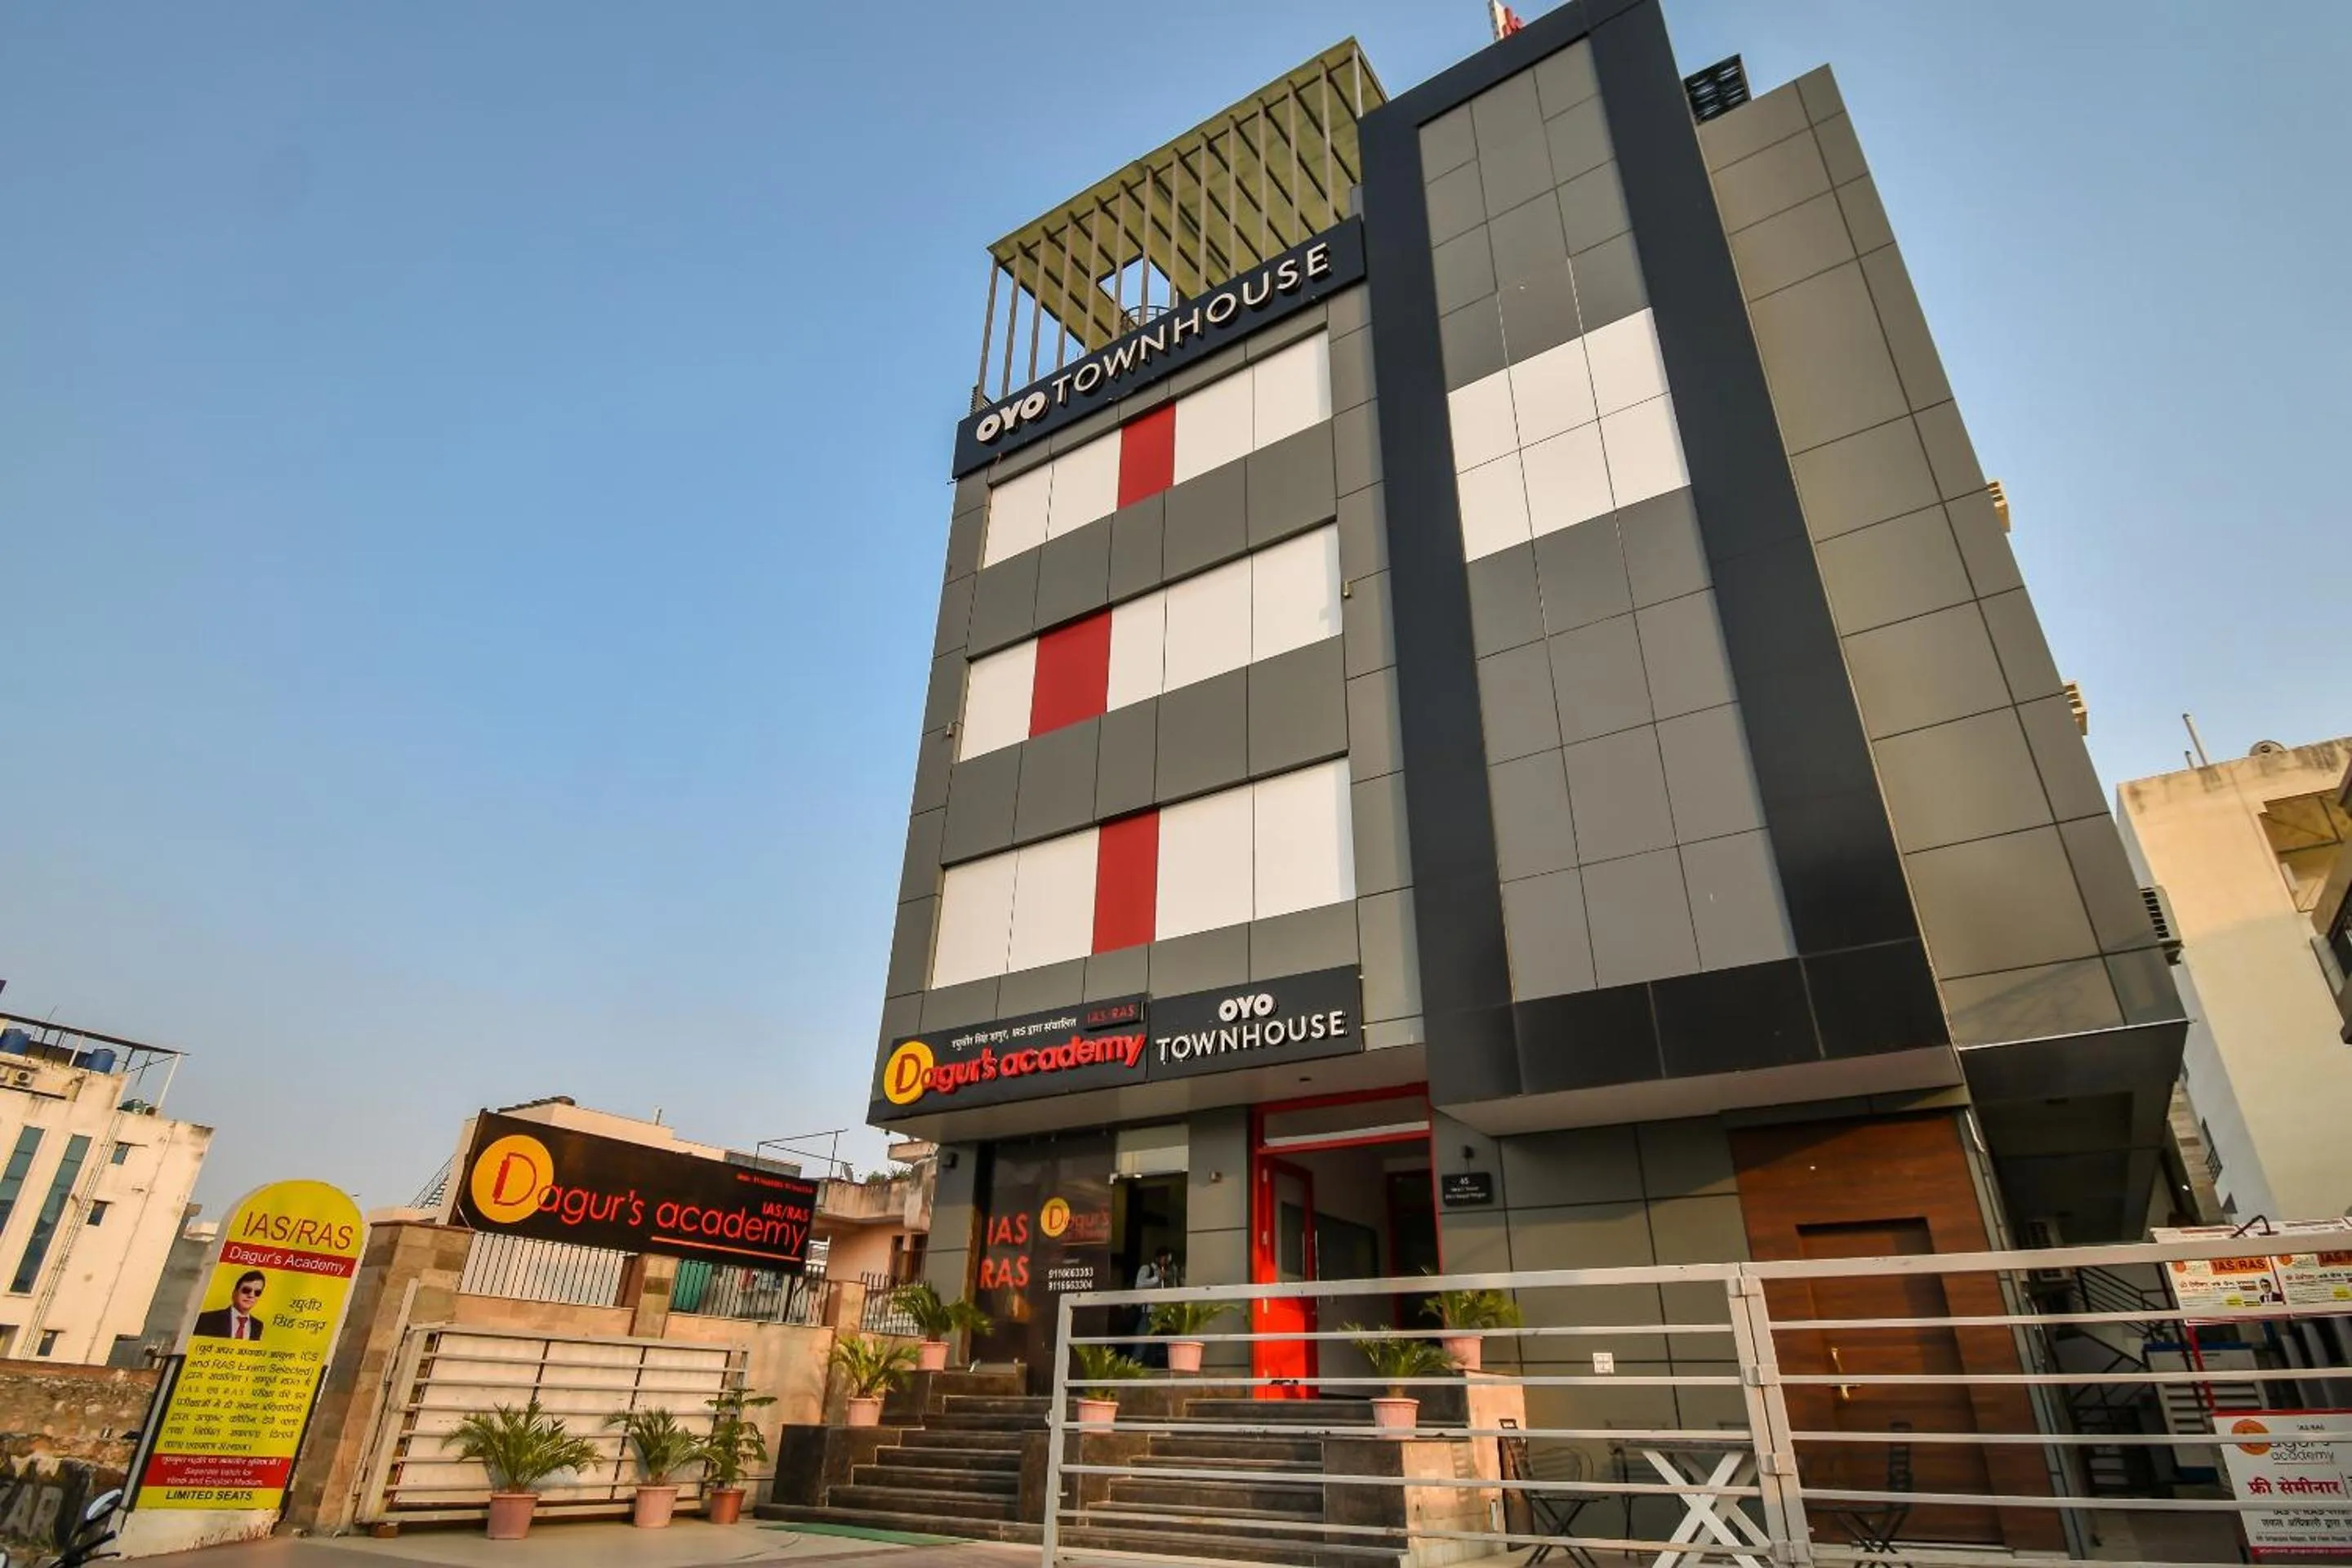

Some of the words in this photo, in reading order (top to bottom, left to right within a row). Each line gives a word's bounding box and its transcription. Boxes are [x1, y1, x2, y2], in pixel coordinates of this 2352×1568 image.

[975, 390, 1049, 443] OYO
[1052, 243, 1331, 406] TOWNHOUSE
[1218, 993, 1276, 1022] OYO
[1156, 1010, 1347, 1062] TOWNHOUSE
[1000, 1033, 1146, 1079] academy
[492, 1151, 645, 1227] Dagur's
[656, 1199, 808, 1256] academy
[762, 1201, 810, 1223] IAS/RAS
[242, 1211, 354, 1250] IAS/RAS
[987, 1213, 1030, 1246] IAS
[228, 1245, 282, 1265] Dagur's
[283, 1254, 346, 1276] Academy
[981, 1255, 1030, 1290] RAS
[212, 1359, 236, 1370] RAS
[2271, 1449, 2335, 1463] academy
[166, 1490, 213, 1500] LIMITED
[216, 1490, 253, 1501] SEATS
[2247, 1476, 2274, 1496] फ्री
